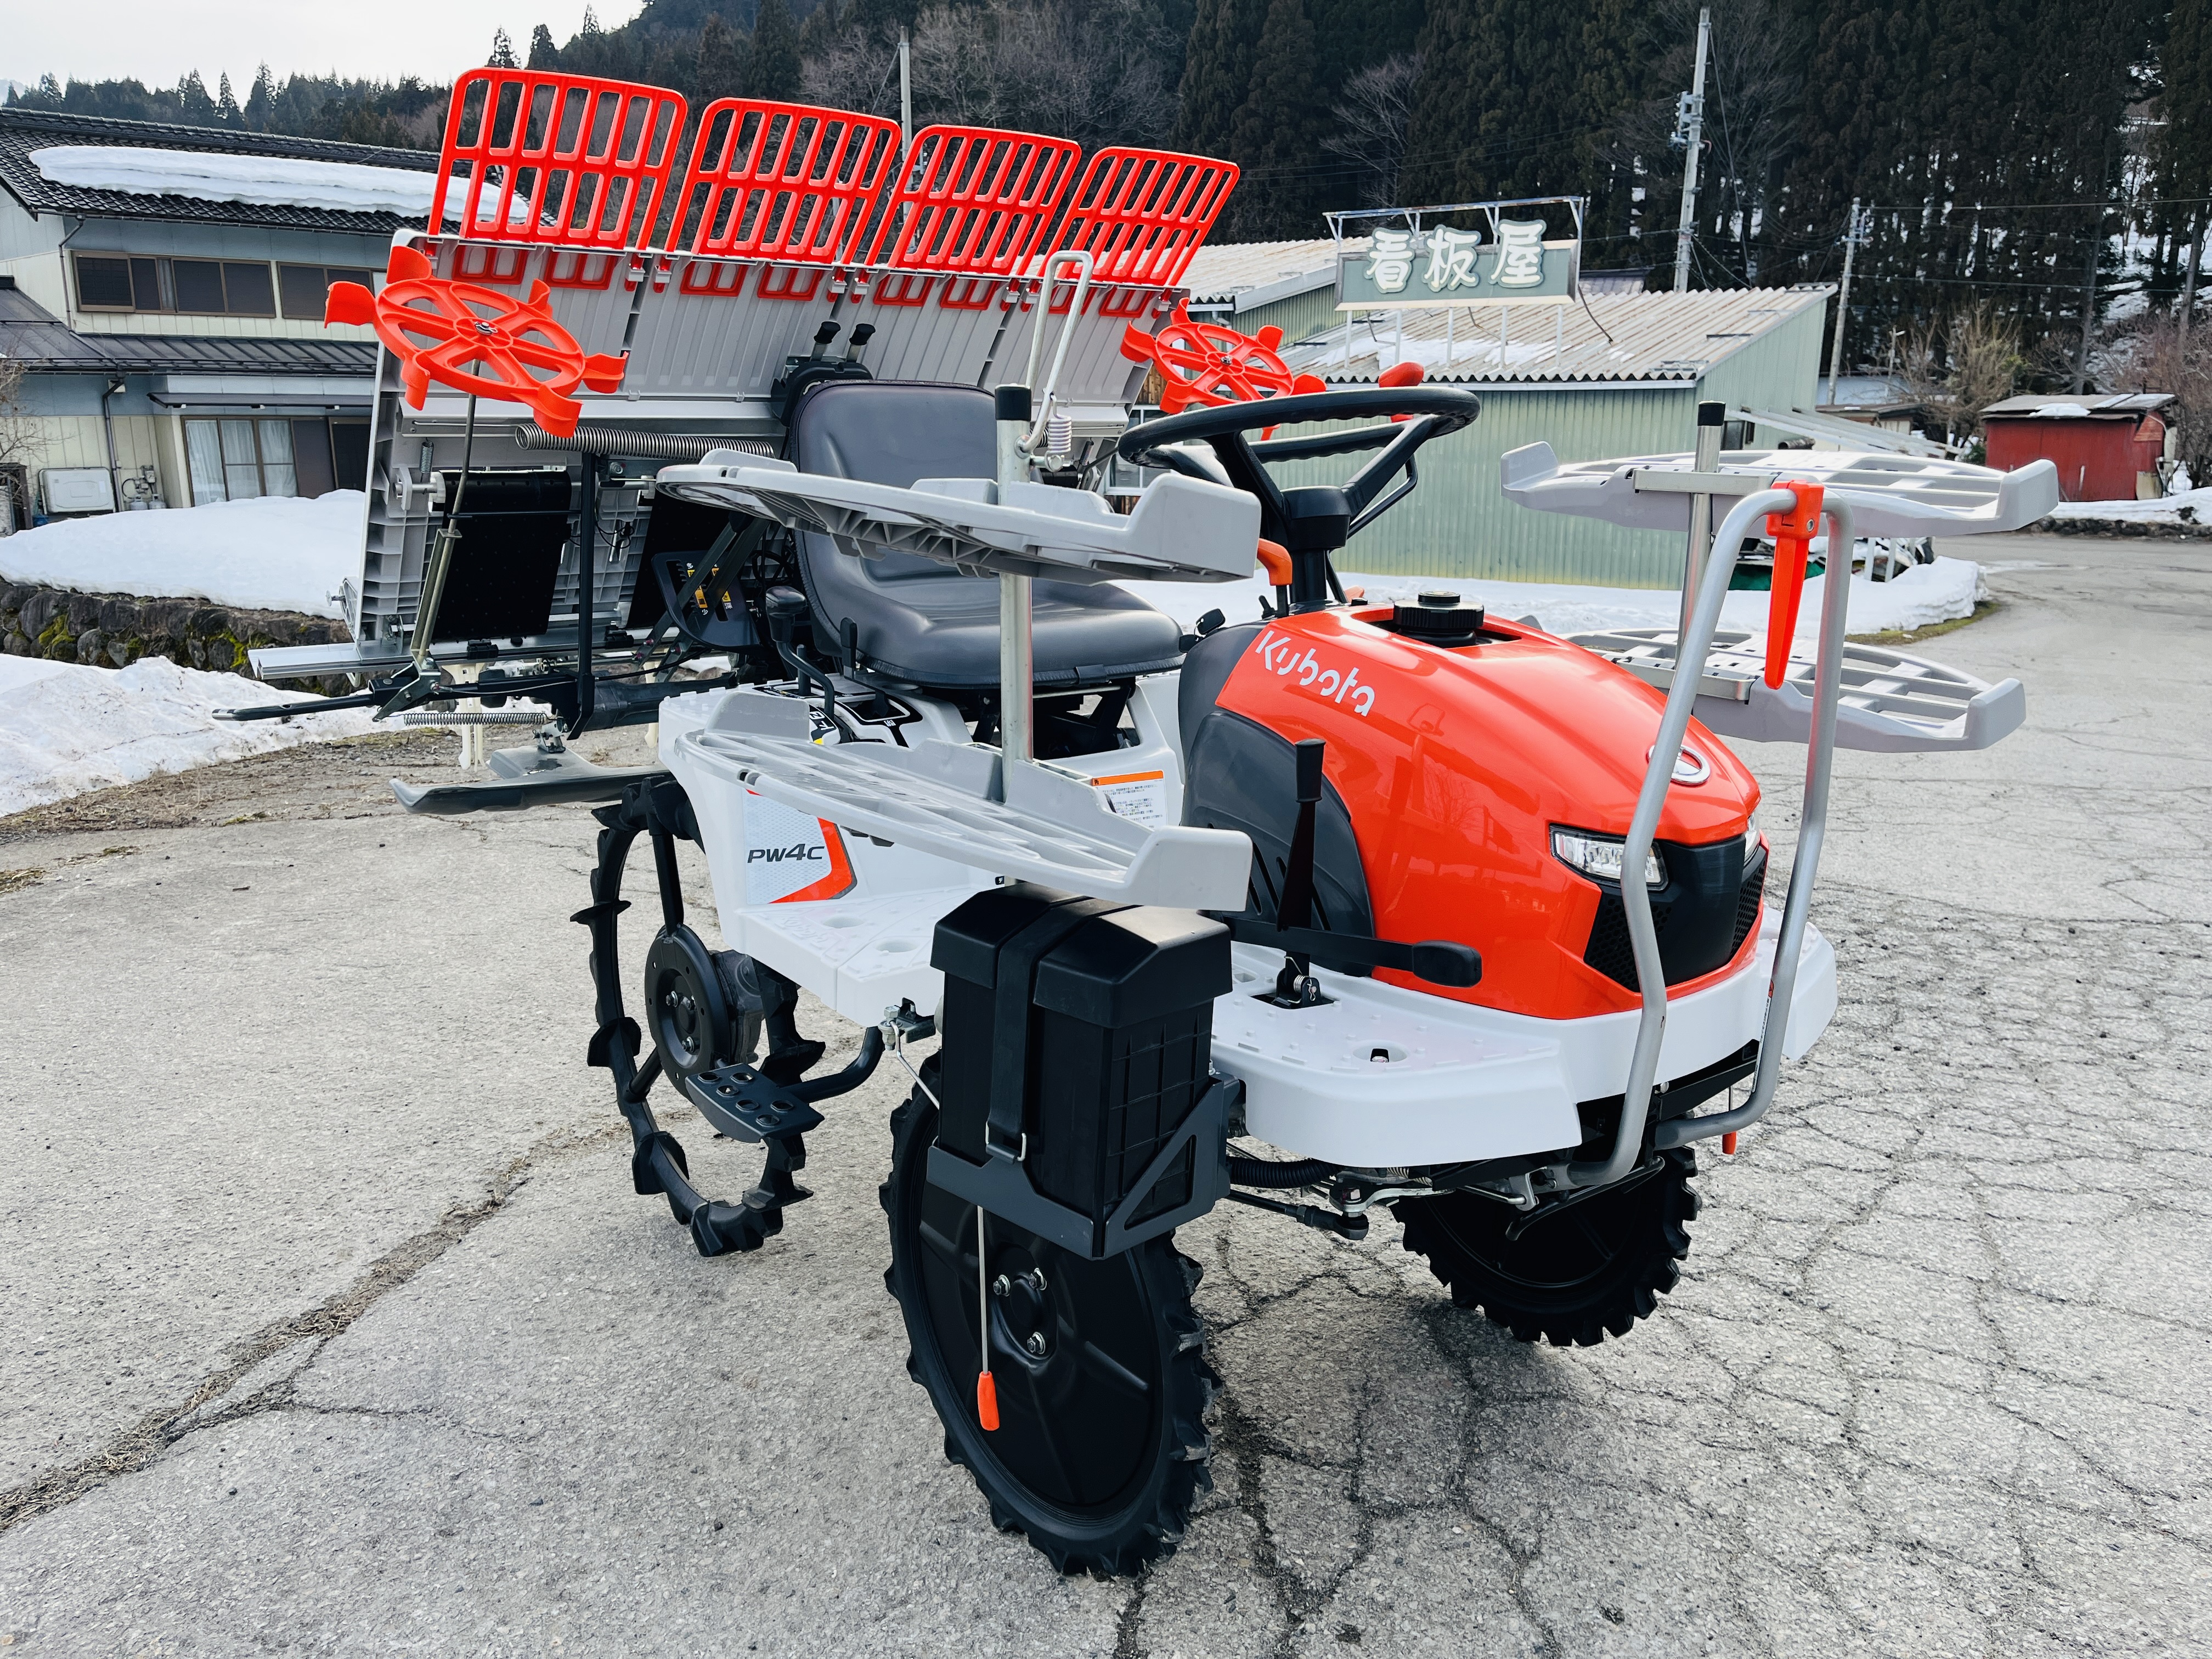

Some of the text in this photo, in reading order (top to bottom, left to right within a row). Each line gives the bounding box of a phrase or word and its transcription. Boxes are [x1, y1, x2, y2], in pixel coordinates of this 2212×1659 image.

[1365, 220, 1545, 292] 看板屋
[1255, 630, 1375, 717] Kubota
[747, 843, 825, 864] PW4C
